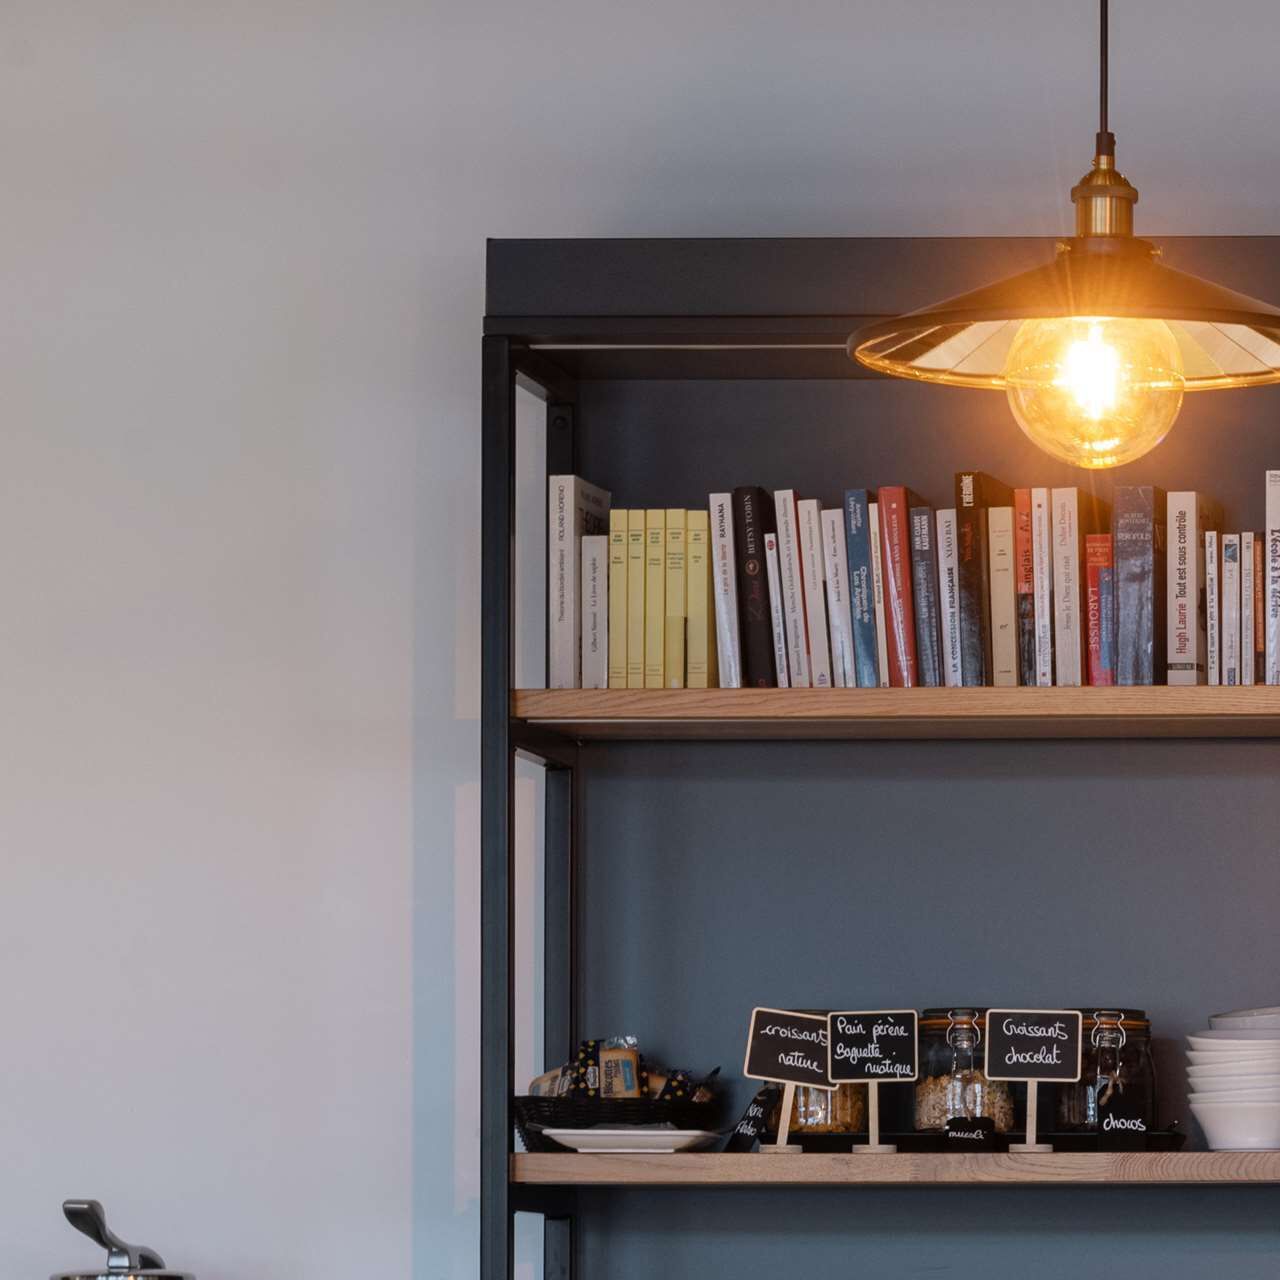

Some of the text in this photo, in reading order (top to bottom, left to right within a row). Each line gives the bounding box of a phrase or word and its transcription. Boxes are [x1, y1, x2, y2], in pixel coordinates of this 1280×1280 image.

[717, 503, 727, 538] RAYHANA
[744, 494, 756, 555] BETSY TOBIN
[944, 519, 954, 559] XIAO BAI
[1175, 510, 1190, 654] Hugh Laurie Tout est sous contrôle
[862, 612, 869, 623] de
[946, 566, 959, 673] LA CONCESSION FRANÇAISE
[1088, 586, 1098, 650] LAROUSSE
[836, 1016, 866, 1035] Pain
[1002, 1018, 1069, 1040] Croissants
[778, 1050, 824, 1073] nature
[834, 1042, 883, 1065] Baguette
[1005, 1043, 1062, 1065] chocolat
[1102, 1112, 1147, 1132] chocos
